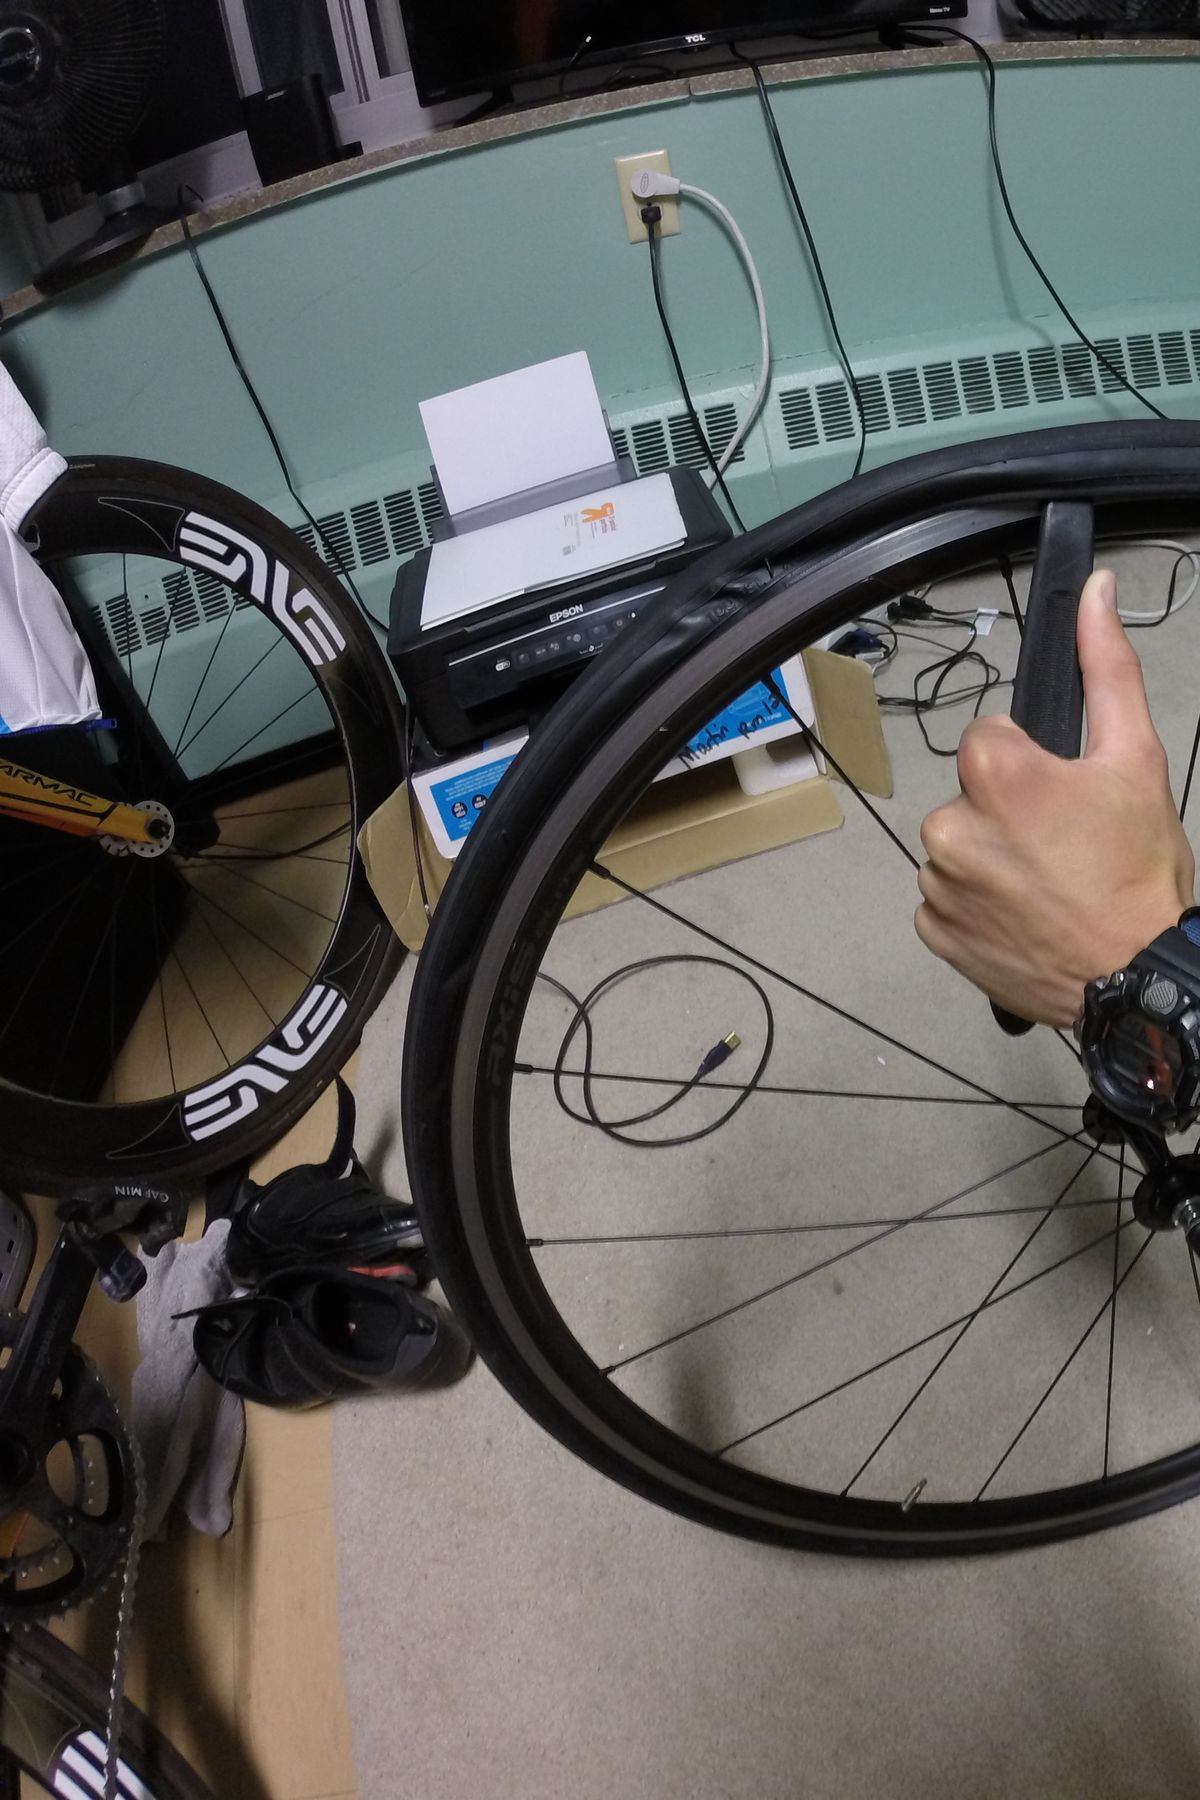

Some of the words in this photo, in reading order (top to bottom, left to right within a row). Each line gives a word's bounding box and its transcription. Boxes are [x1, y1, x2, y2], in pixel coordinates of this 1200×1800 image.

[685, 34, 706, 43] TCL
[550, 603, 584, 622] EPSON
[0, 764, 98, 807] ARMAC
